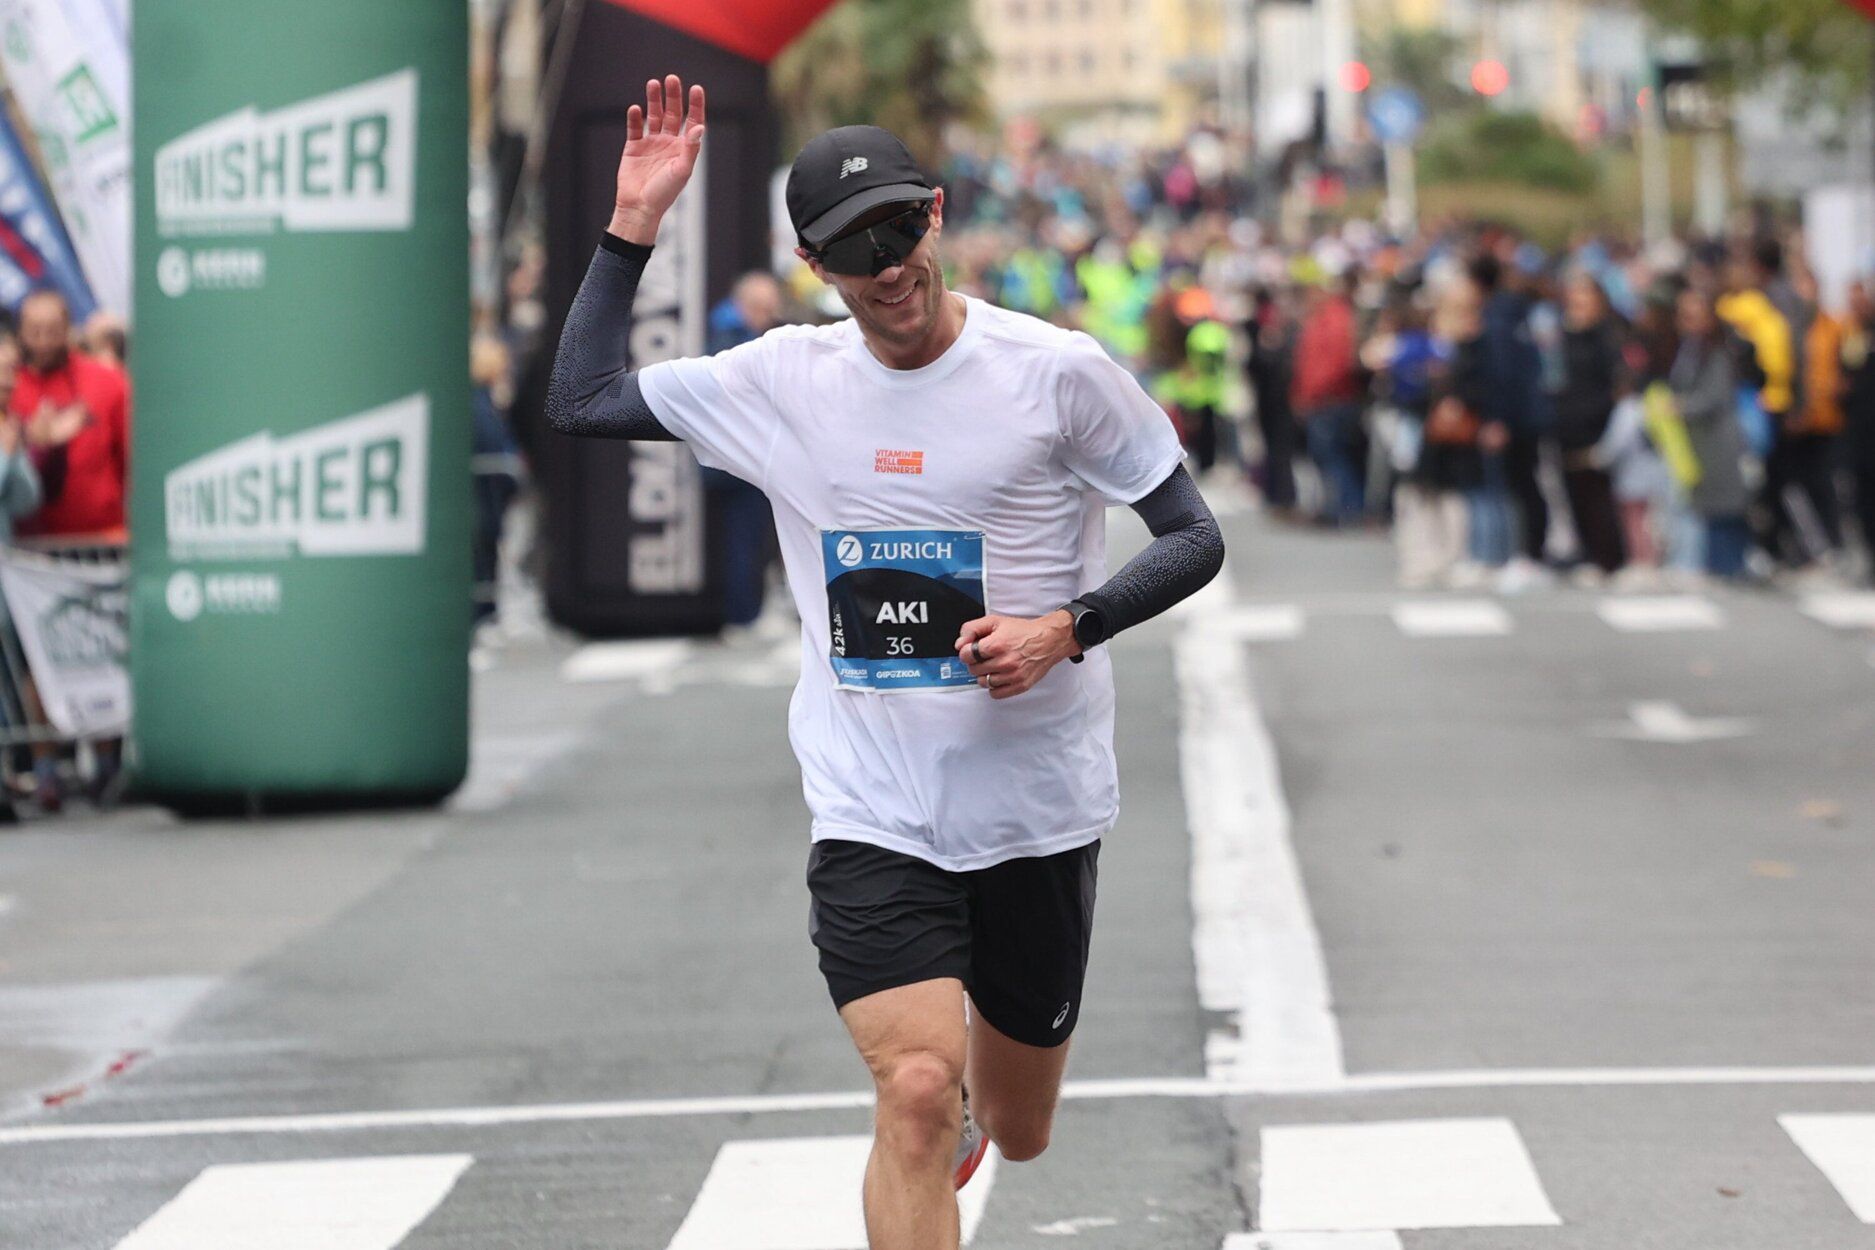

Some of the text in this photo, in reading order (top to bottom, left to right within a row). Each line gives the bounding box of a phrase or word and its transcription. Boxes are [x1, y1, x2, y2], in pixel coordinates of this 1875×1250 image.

[158, 112, 389, 203] FINISHER
[874, 457, 897, 466] WELL
[875, 449, 911, 458] VITAMIN
[874, 464, 916, 474] RUNNERS
[169, 437, 402, 525] FINISHER
[870, 541, 953, 560] ZURICH
[875, 601, 929, 624] AKI
[832, 627, 846, 657] 42k
[886, 636, 914, 656] 36
